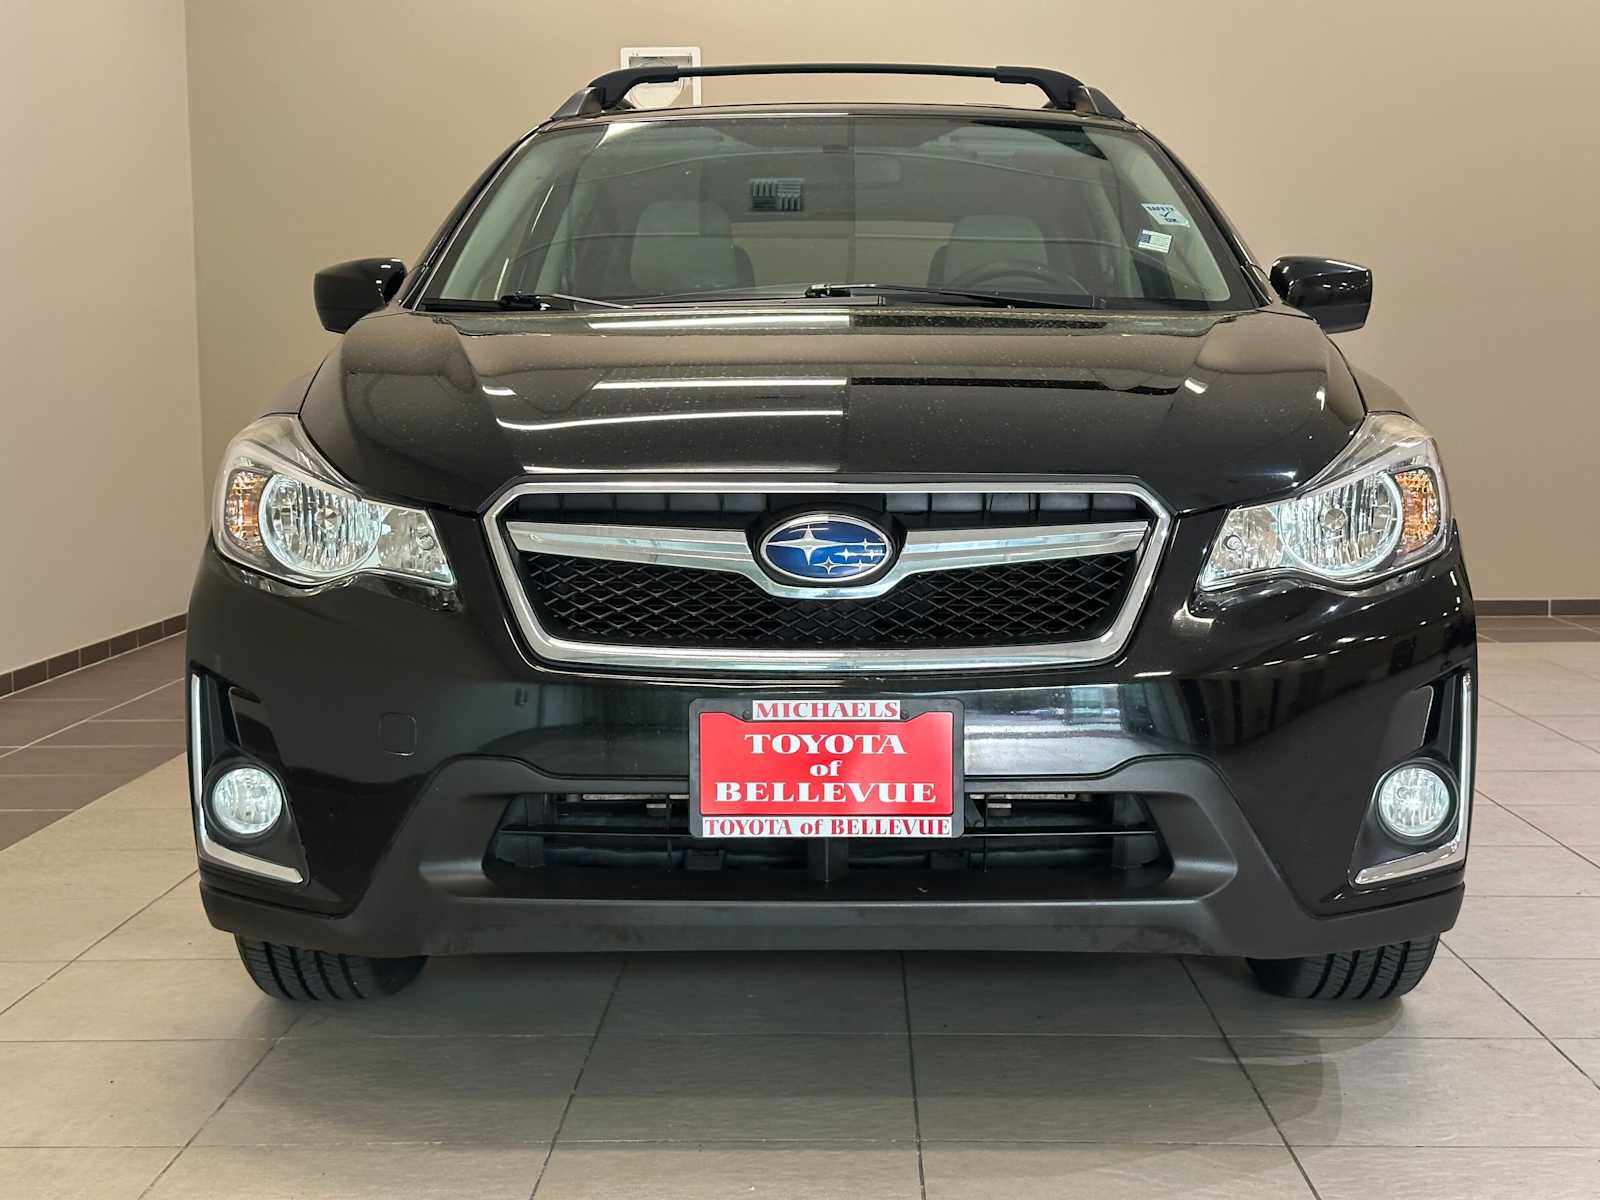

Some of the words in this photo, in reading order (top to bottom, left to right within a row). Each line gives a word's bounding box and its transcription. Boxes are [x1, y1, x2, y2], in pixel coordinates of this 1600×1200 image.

[756, 702, 898, 718] MICHAELS
[744, 734, 907, 754] TOYOTA
[809, 760, 842, 777] of
[714, 782, 936, 803] BELLEVUE
[705, 819, 792, 835] TOYOTA
[800, 819, 823, 835] of
[831, 819, 950, 835] BELLEVUE
